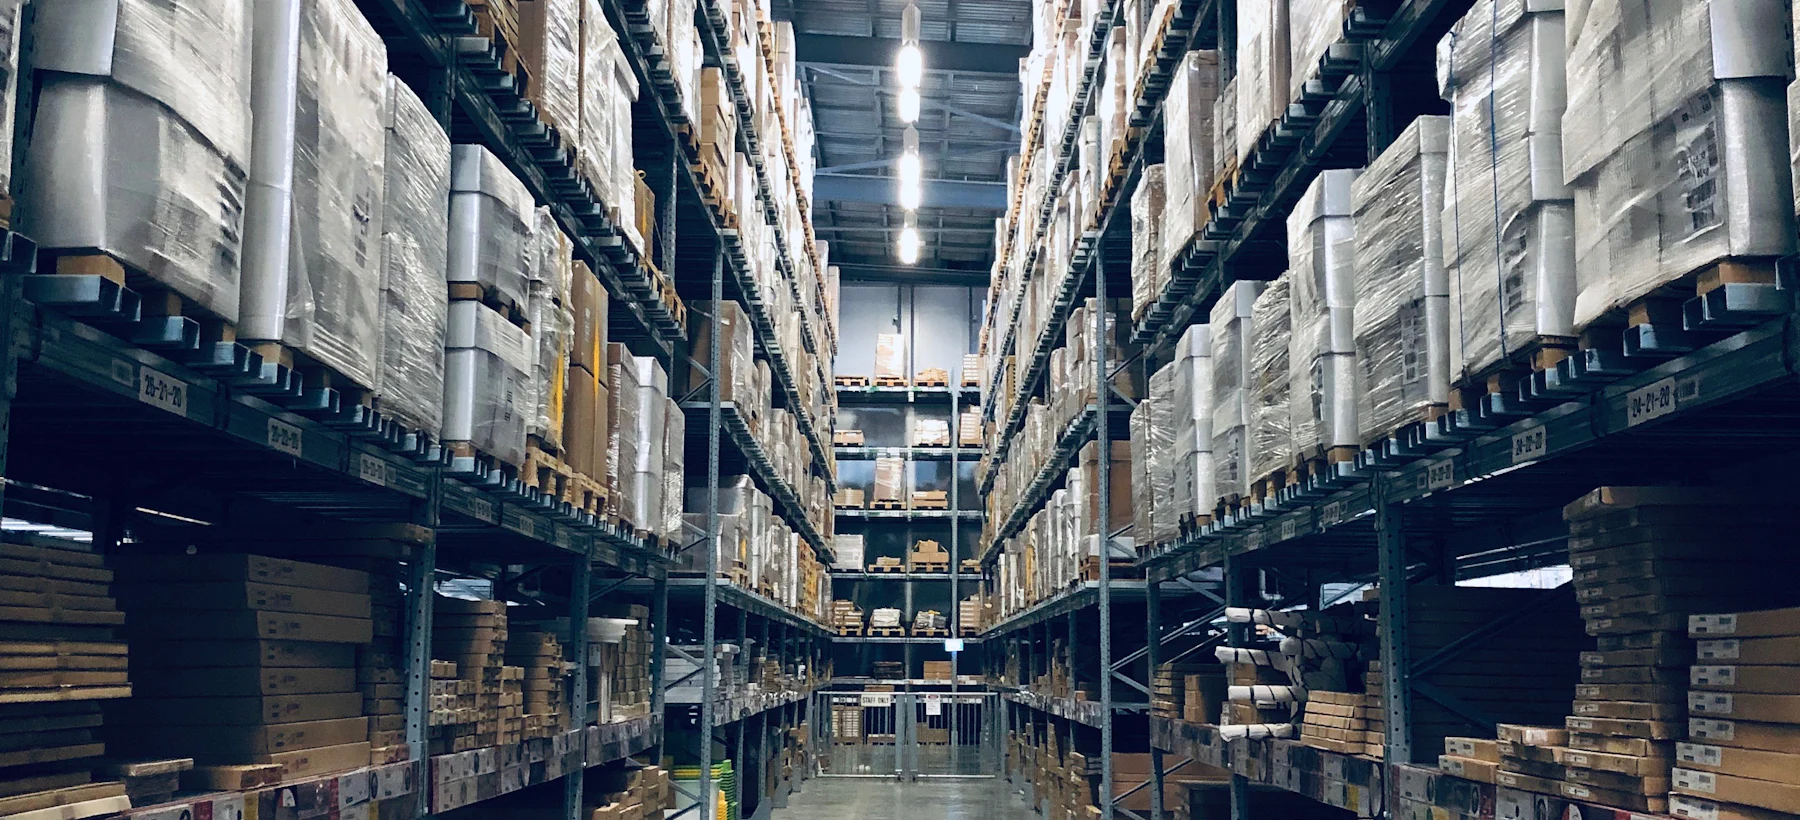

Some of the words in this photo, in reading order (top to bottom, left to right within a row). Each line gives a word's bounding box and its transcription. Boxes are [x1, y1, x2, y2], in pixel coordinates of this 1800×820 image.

[145, 374, 182, 407] 26-21-20
[1632, 385, 1670, 418] 24-21-20
[862, 696, 876, 704] STAFF
